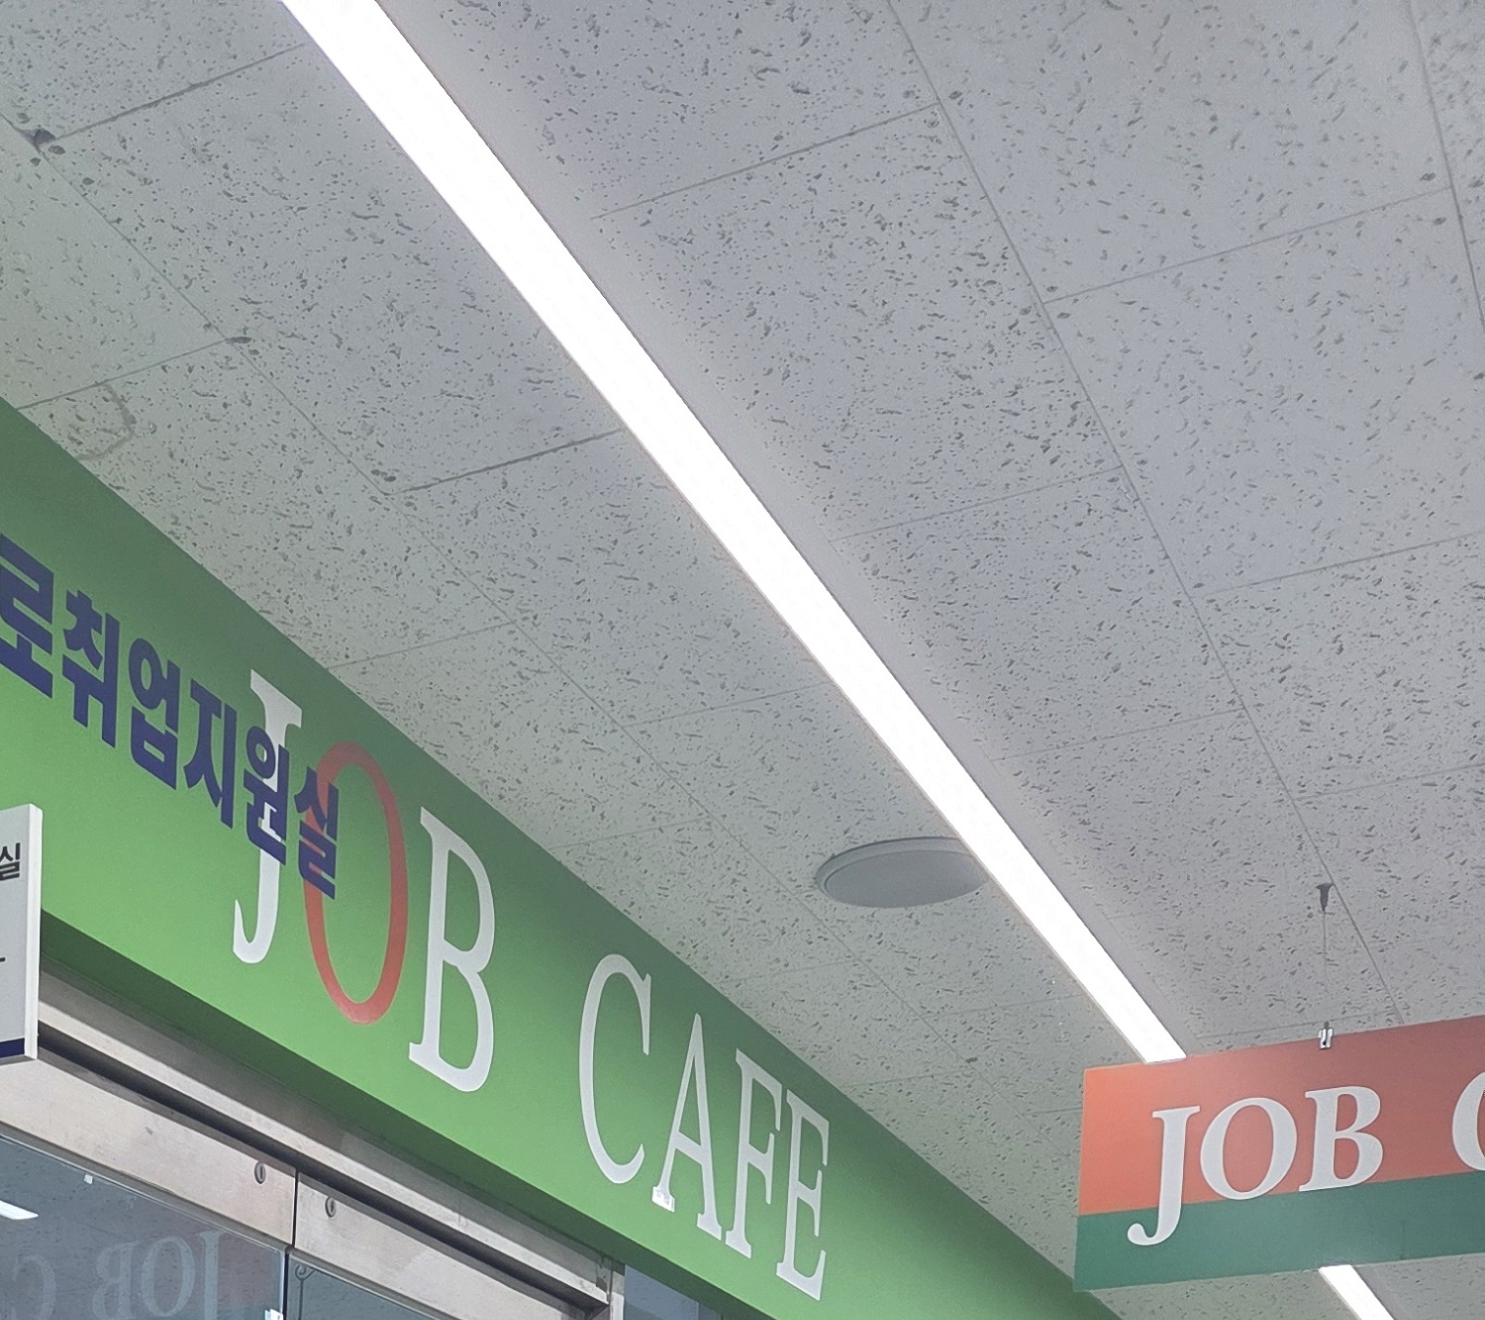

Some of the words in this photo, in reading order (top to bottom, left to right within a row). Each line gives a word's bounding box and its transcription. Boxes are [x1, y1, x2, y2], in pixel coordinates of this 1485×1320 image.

[232, 670, 495, 1092] JOB
[579, 954, 830, 1300] CAFE
[1127, 1085, 1383, 1246] JOB
